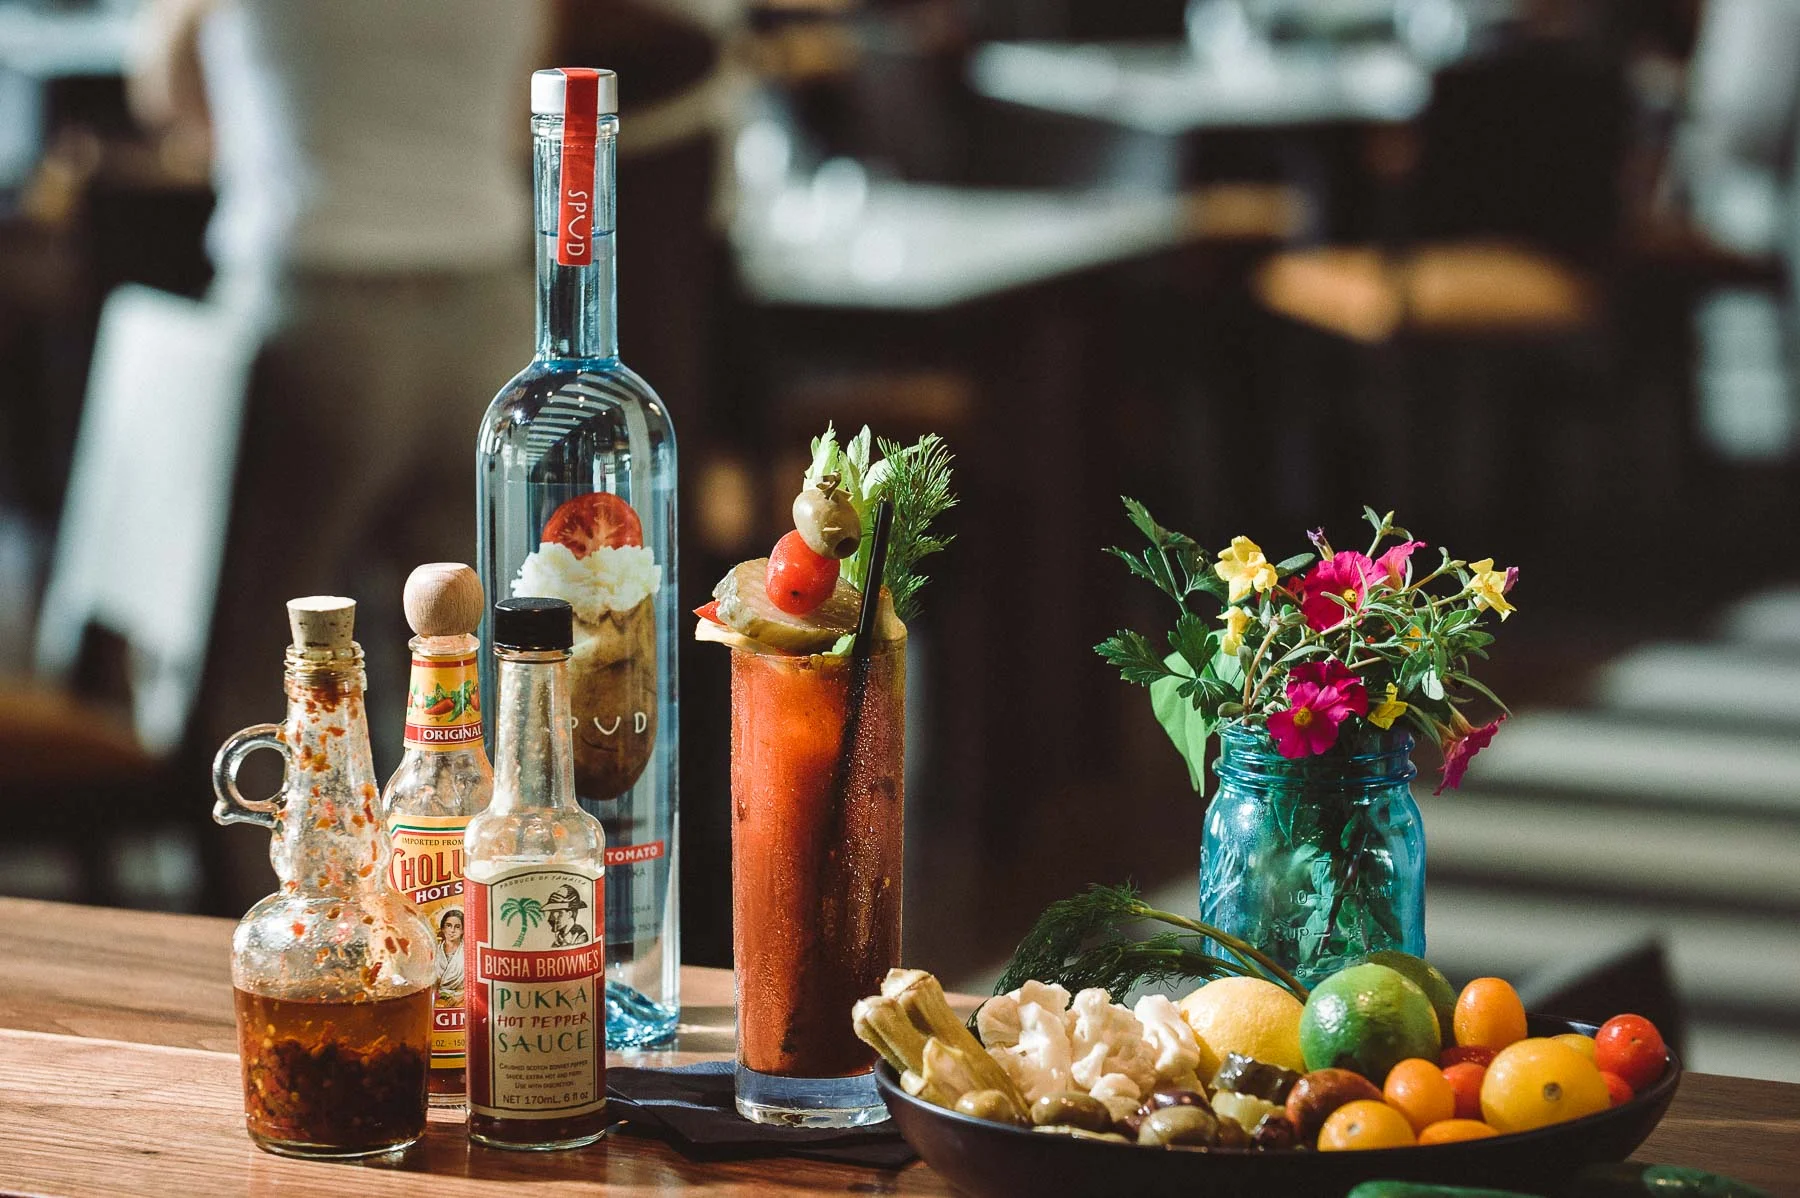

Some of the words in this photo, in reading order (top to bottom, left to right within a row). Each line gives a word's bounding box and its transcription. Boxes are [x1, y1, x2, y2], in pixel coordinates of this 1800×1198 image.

[566, 190, 588, 256] SPUD
[423, 725, 482, 741] ORIGINAL
[402, 837, 440, 847] IMPORTED
[606, 845, 658, 862] TOMATO
[415, 885, 450, 904] HOT
[484, 954, 531, 978] BUSHA
[536, 949, 599, 978] BROWNE'S
[496, 984, 587, 1011] PUKKA
[497, 1014, 526, 1029] HOT
[530, 1011, 592, 1029] PEPPER
[498, 1030, 589, 1053] SAUCE
[502, 1094, 521, 1105] NET
[563, 1092, 570, 1103] 6
